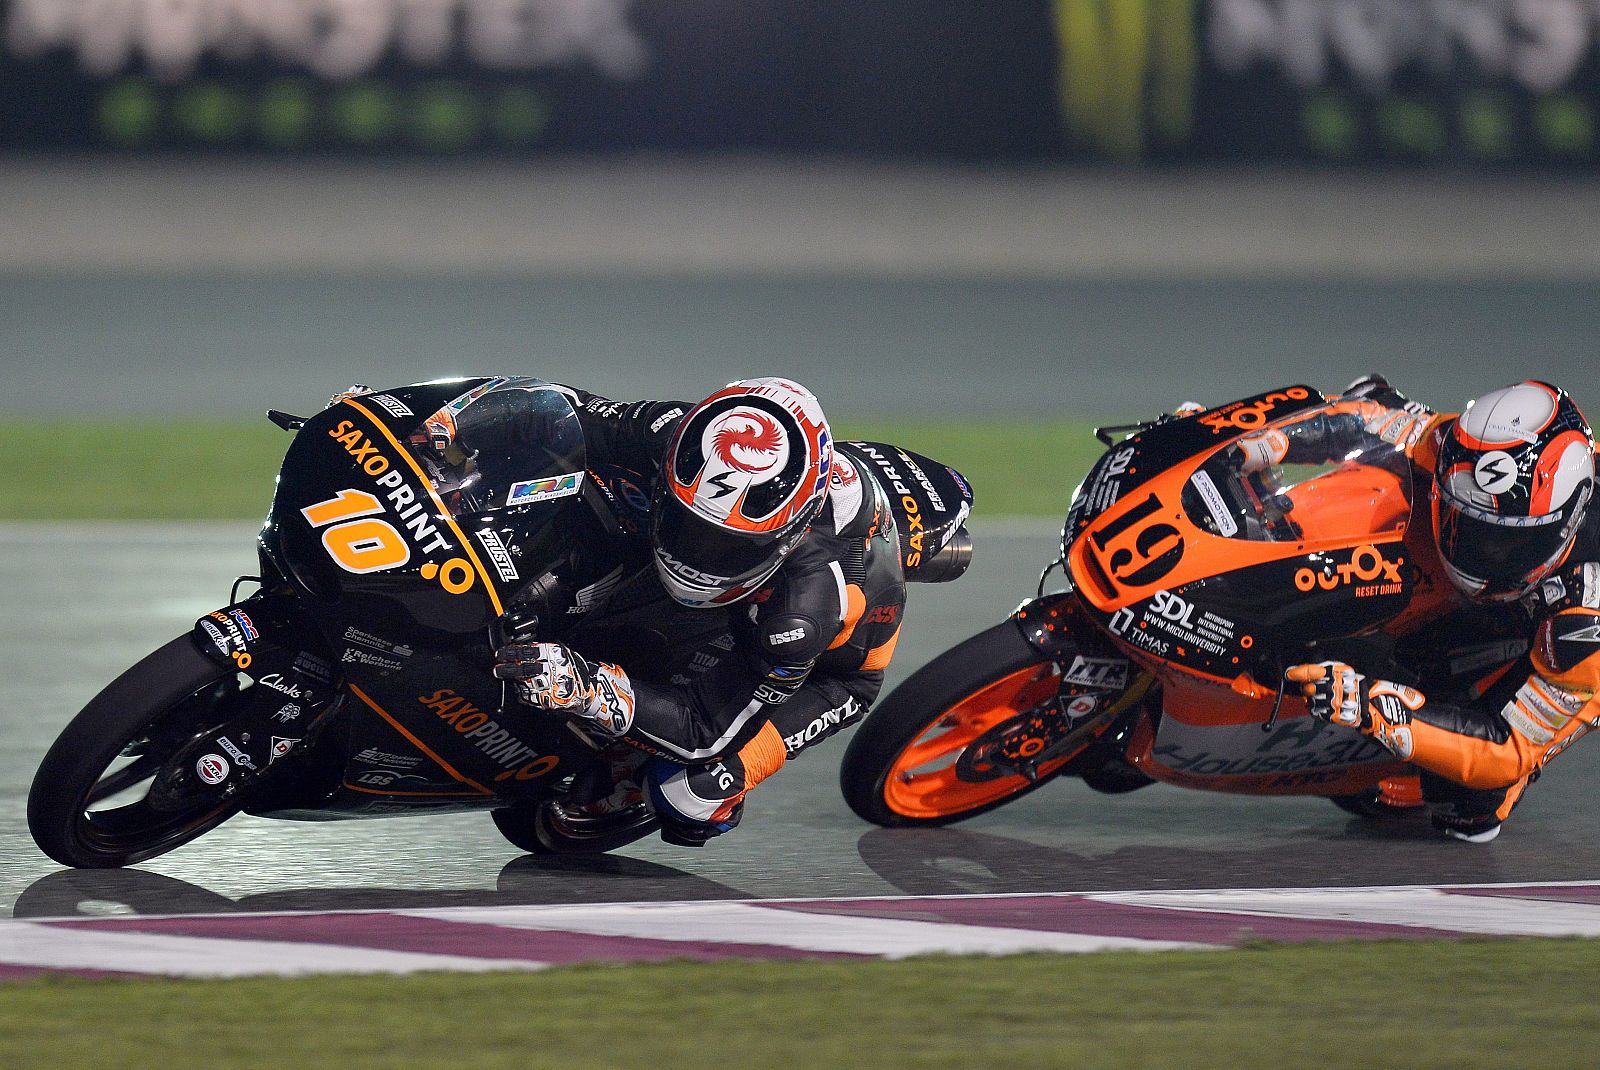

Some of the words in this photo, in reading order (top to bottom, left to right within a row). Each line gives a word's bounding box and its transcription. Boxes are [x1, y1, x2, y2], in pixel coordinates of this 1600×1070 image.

[328, 420, 453, 555] SAXOPRINT
[300, 488, 411, 574] 10
[1092, 492, 1185, 587] 19
[1355, 585, 1378, 599] RESET
[1379, 583, 1403, 596] DRINK
[1149, 589, 1195, 630] SDL
[1204, 611, 1235, 628] MOTORSPORT
[1131, 627, 1170, 654] TIMAS
[1197, 617, 1235, 640] INTERNATIONAL
[354, 649, 401, 667] Reichert
[259, 673, 302, 698] Clarks
[418, 688, 539, 769] SAXOPRINT
[202, 758, 223, 780] MAKRA
[357, 772, 394, 786] LBS
